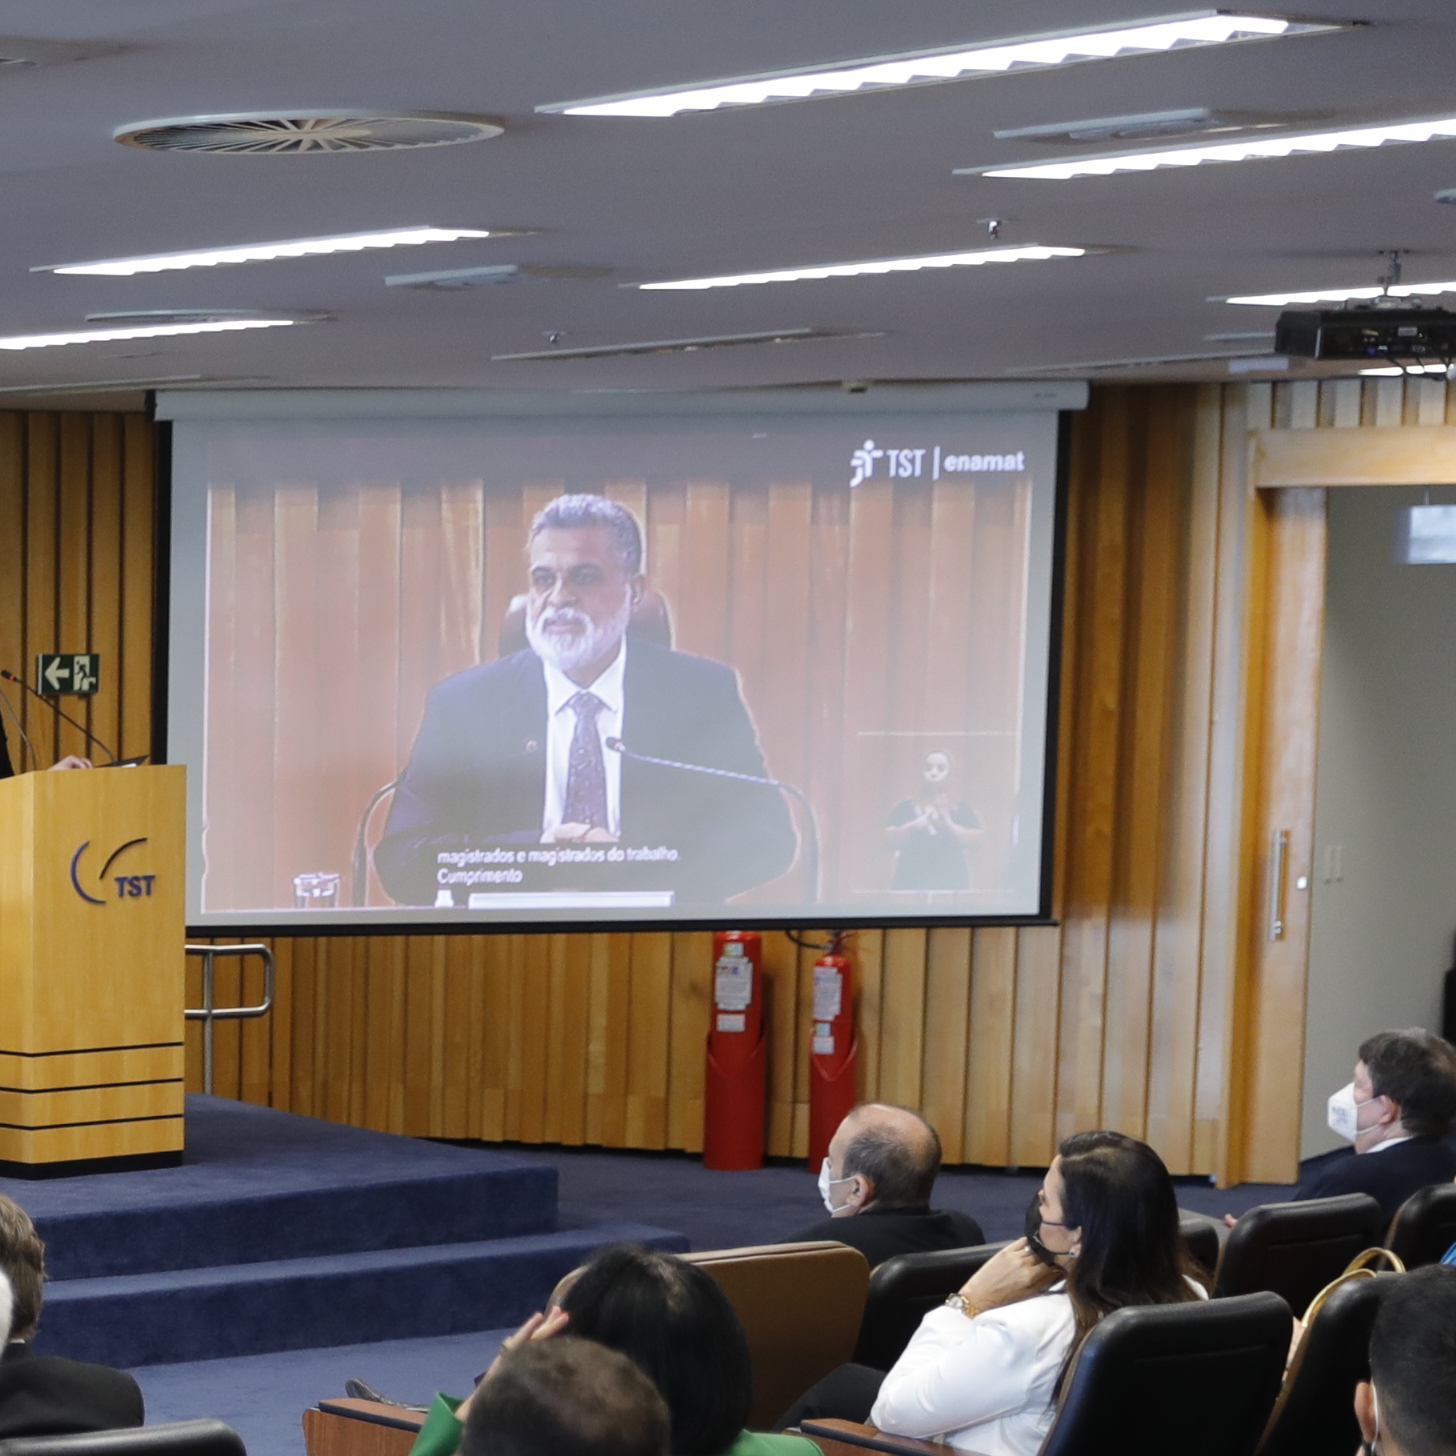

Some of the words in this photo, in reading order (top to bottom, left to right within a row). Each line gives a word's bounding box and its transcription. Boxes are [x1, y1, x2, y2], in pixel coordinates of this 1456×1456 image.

[886, 448, 926, 478] TST
[943, 450, 1025, 472] enamat
[516, 851, 527, 863] e
[606, 845, 625, 862] do
[114, 875, 156, 898] TST
